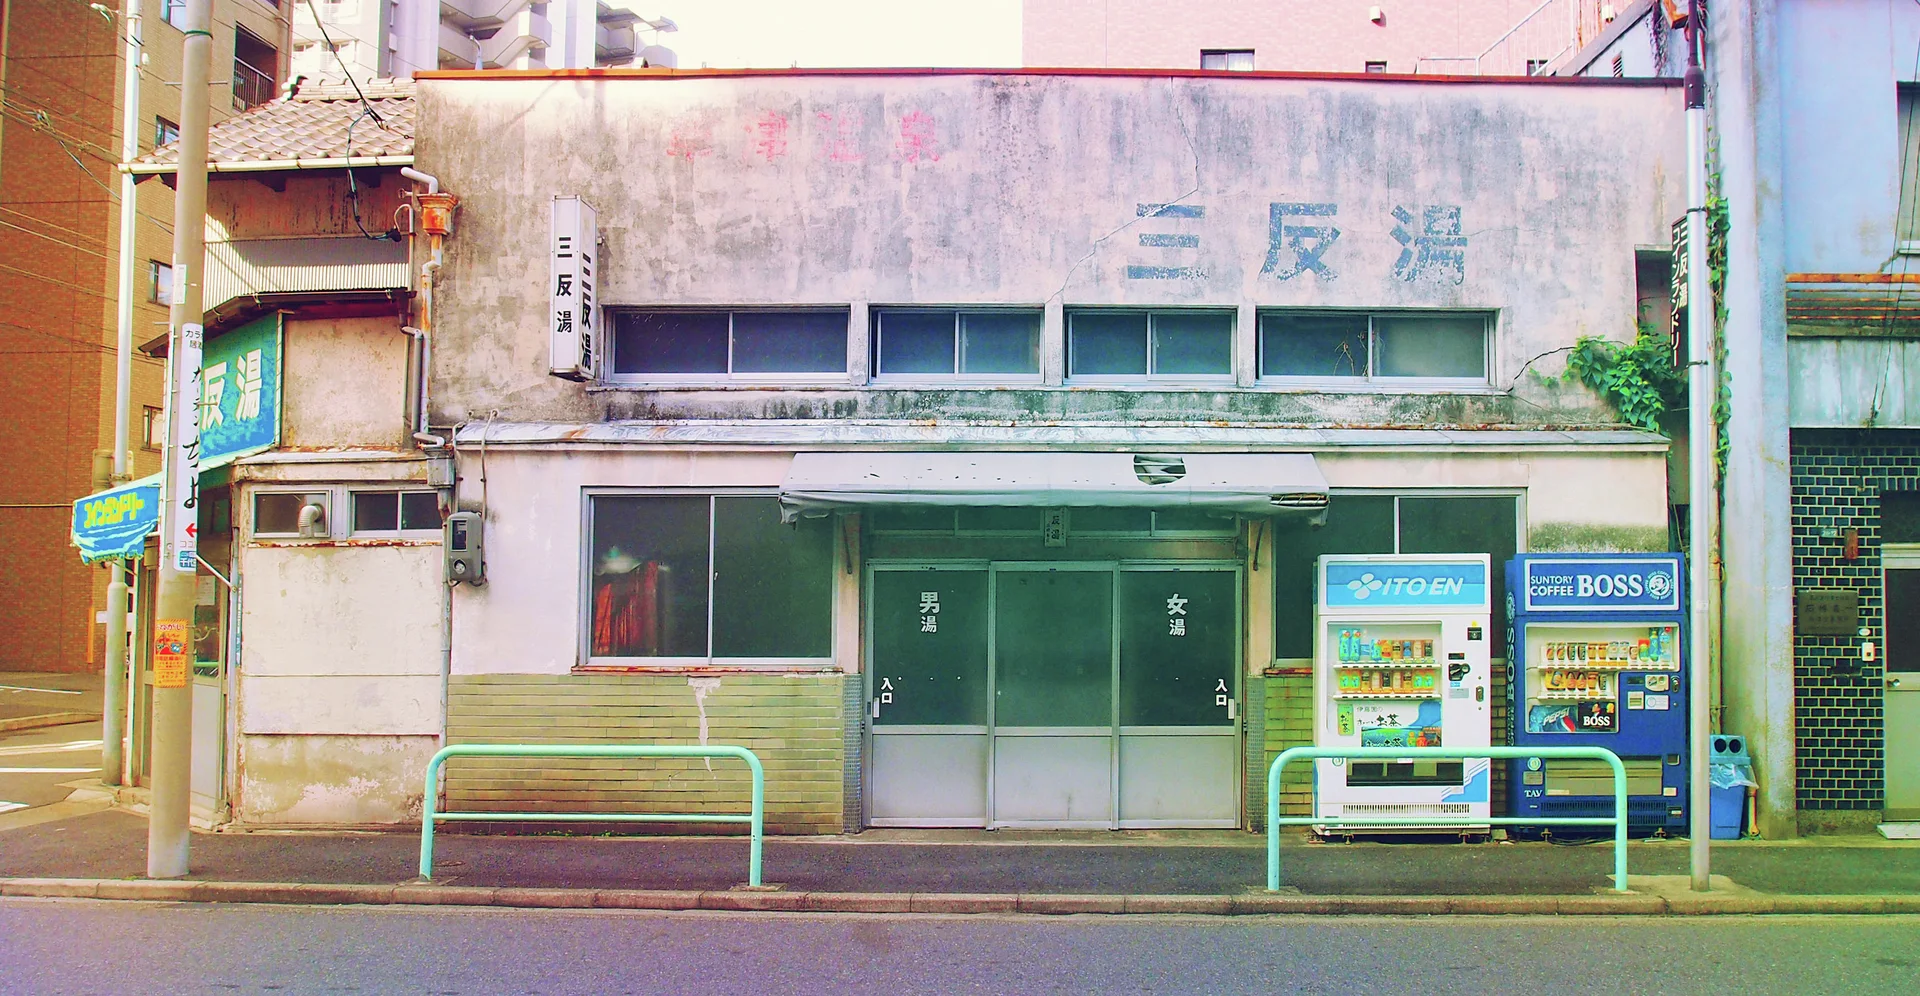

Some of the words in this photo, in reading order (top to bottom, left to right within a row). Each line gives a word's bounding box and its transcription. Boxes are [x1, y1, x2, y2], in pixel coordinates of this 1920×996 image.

[1127, 202, 1468, 285] 三反湯
[556, 236, 573, 333] 三反湯
[1671, 227, 1681, 366] コインランドリー
[581, 252, 592, 370] 三反湯
[1382, 577, 1427, 596] ITO
[1429, 577, 1464, 595] EN
[1530, 575, 1574, 584] SUNTORY
[1530, 586, 1574, 596] COFFEE
[1576, 574, 1643, 597] BOSS
[920, 591, 940, 632] 男湯
[1167, 593, 1188, 636] 女湯
[880, 677, 894, 704] 入口
[1215, 678, 1228, 706] 入口
[1583, 716, 1610, 726] BOSS
